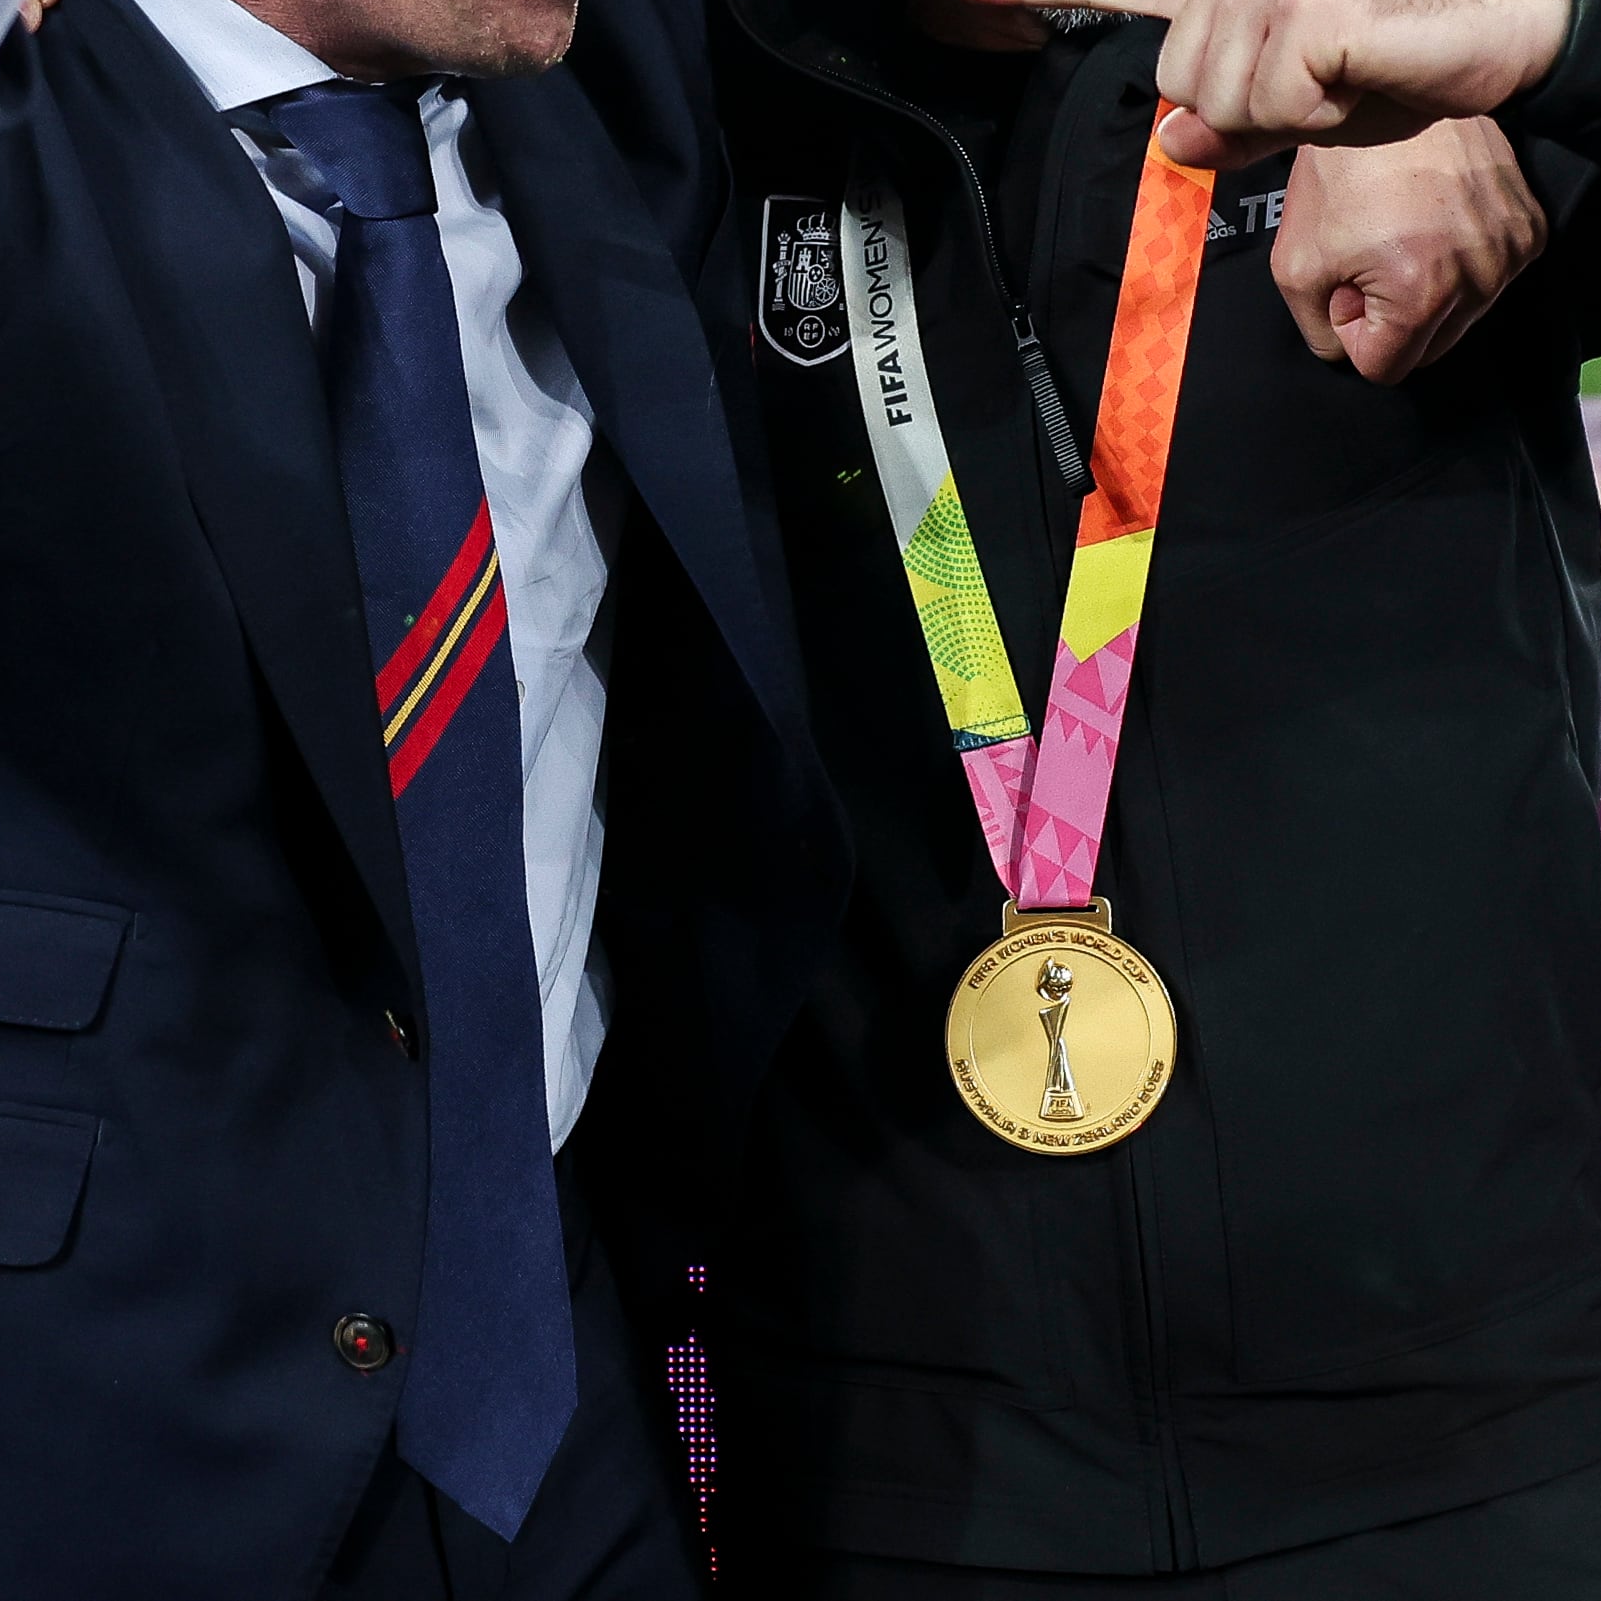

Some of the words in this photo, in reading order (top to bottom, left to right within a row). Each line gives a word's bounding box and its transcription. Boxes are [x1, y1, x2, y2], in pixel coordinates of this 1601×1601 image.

[860, 189, 896, 351] WOMEN'S
[877, 349, 913, 427] FIFA
[1070, 932, 1122, 960] WORLD
